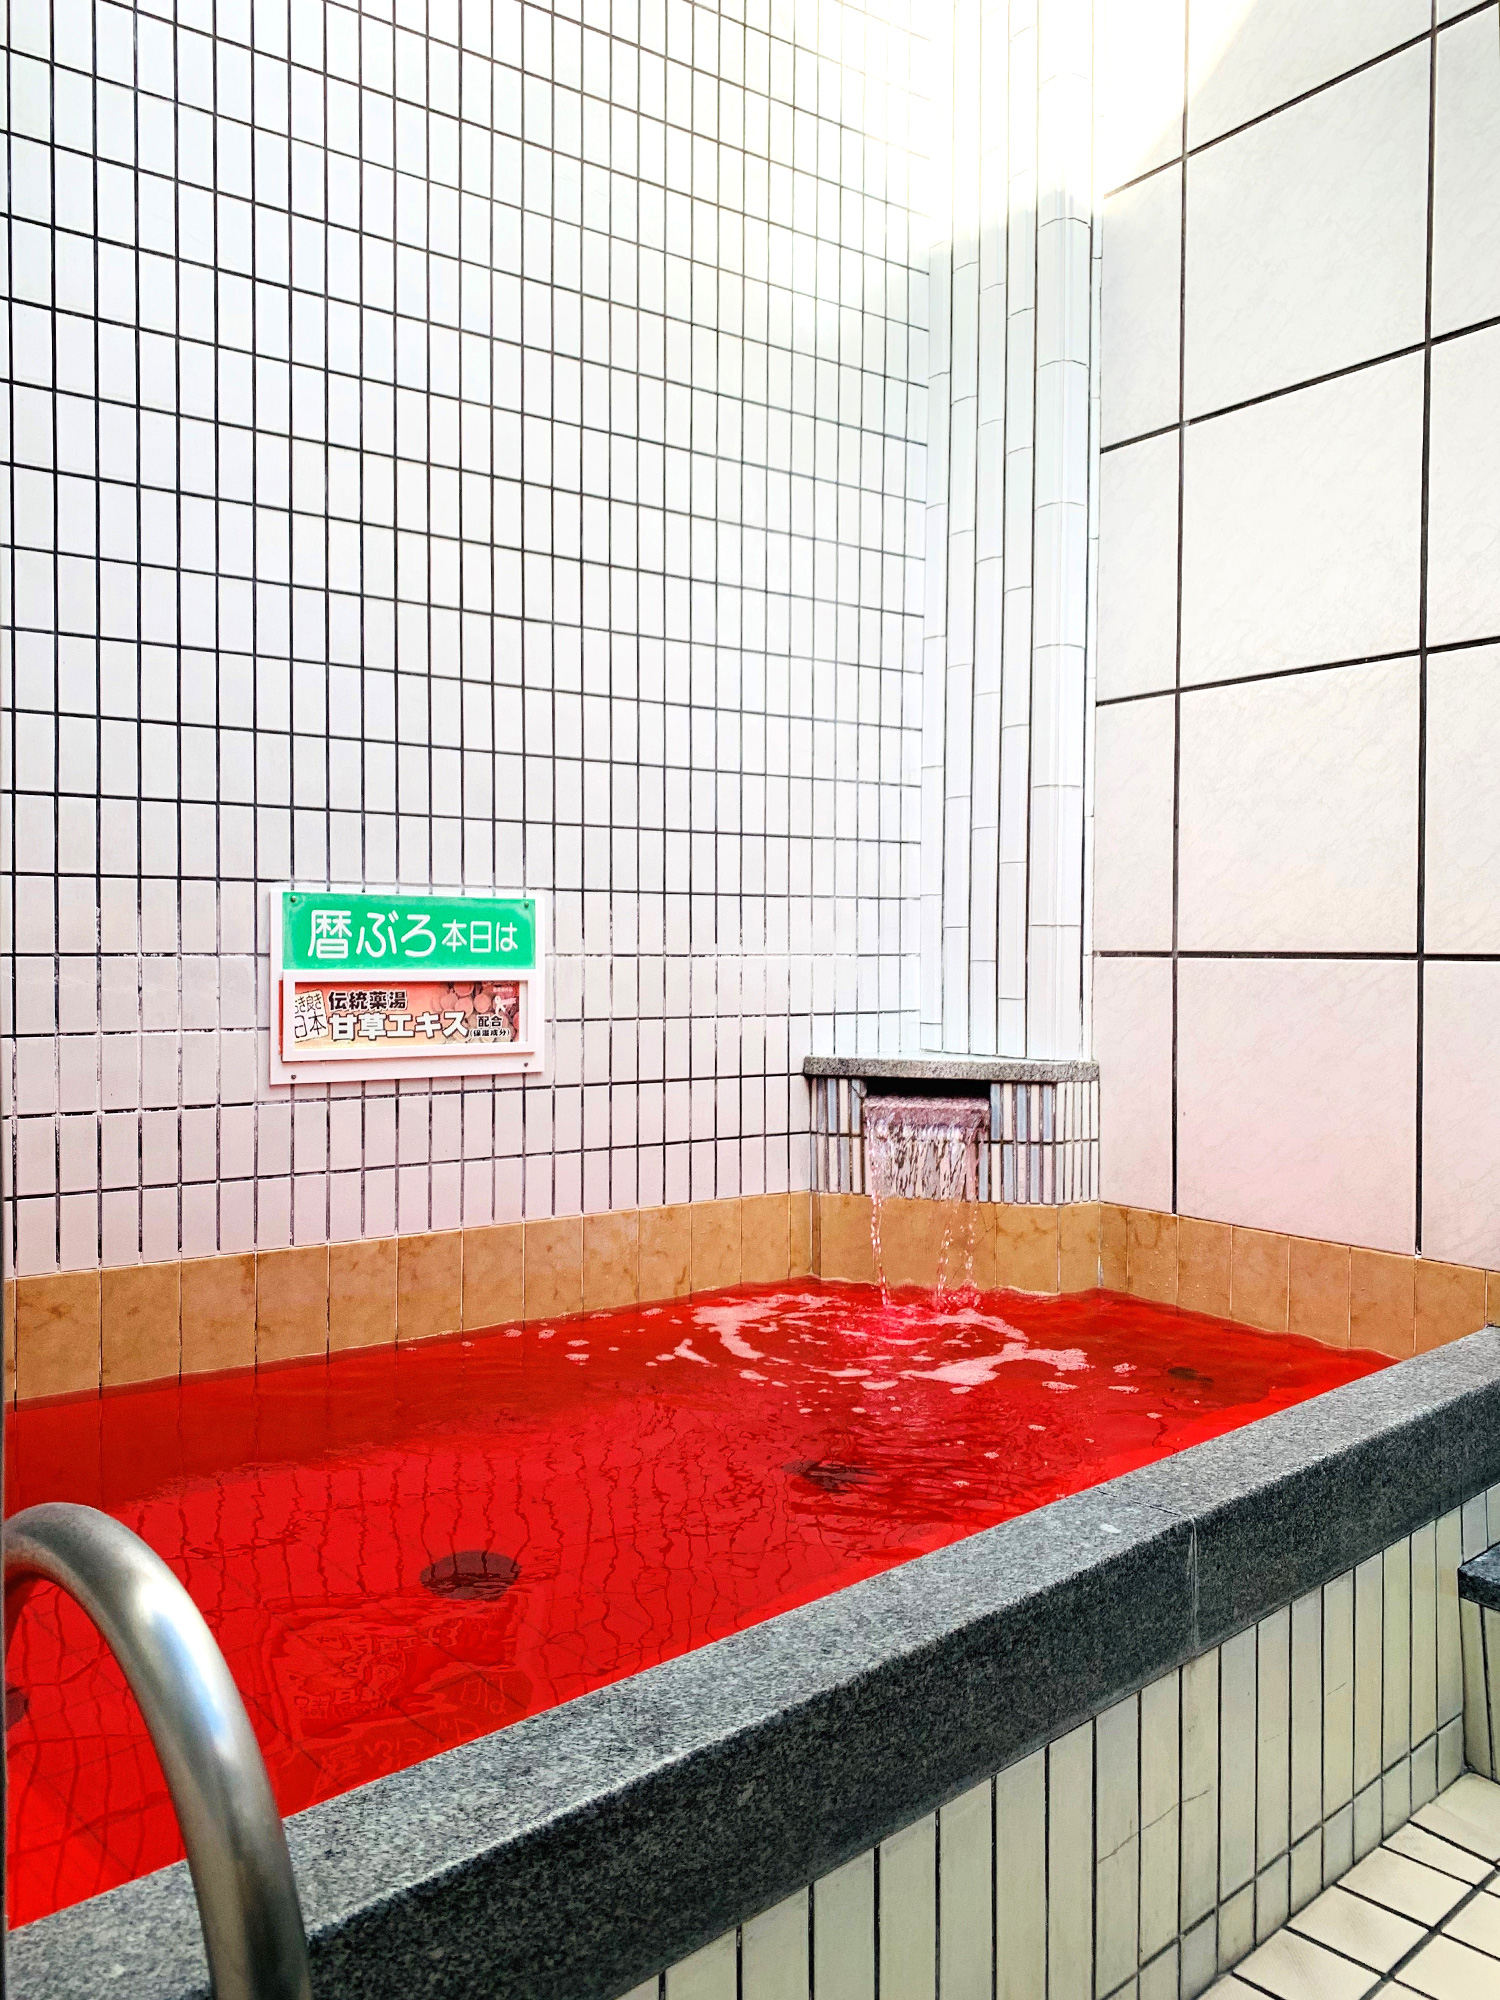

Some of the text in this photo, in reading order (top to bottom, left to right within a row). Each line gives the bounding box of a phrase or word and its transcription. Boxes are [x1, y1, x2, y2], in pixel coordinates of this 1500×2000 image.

[329, 991, 406, 1010] 伝統薬湯
[329, 1011, 469, 1041] 甘草エキス
[478, 1016, 502, 1027] 配合
